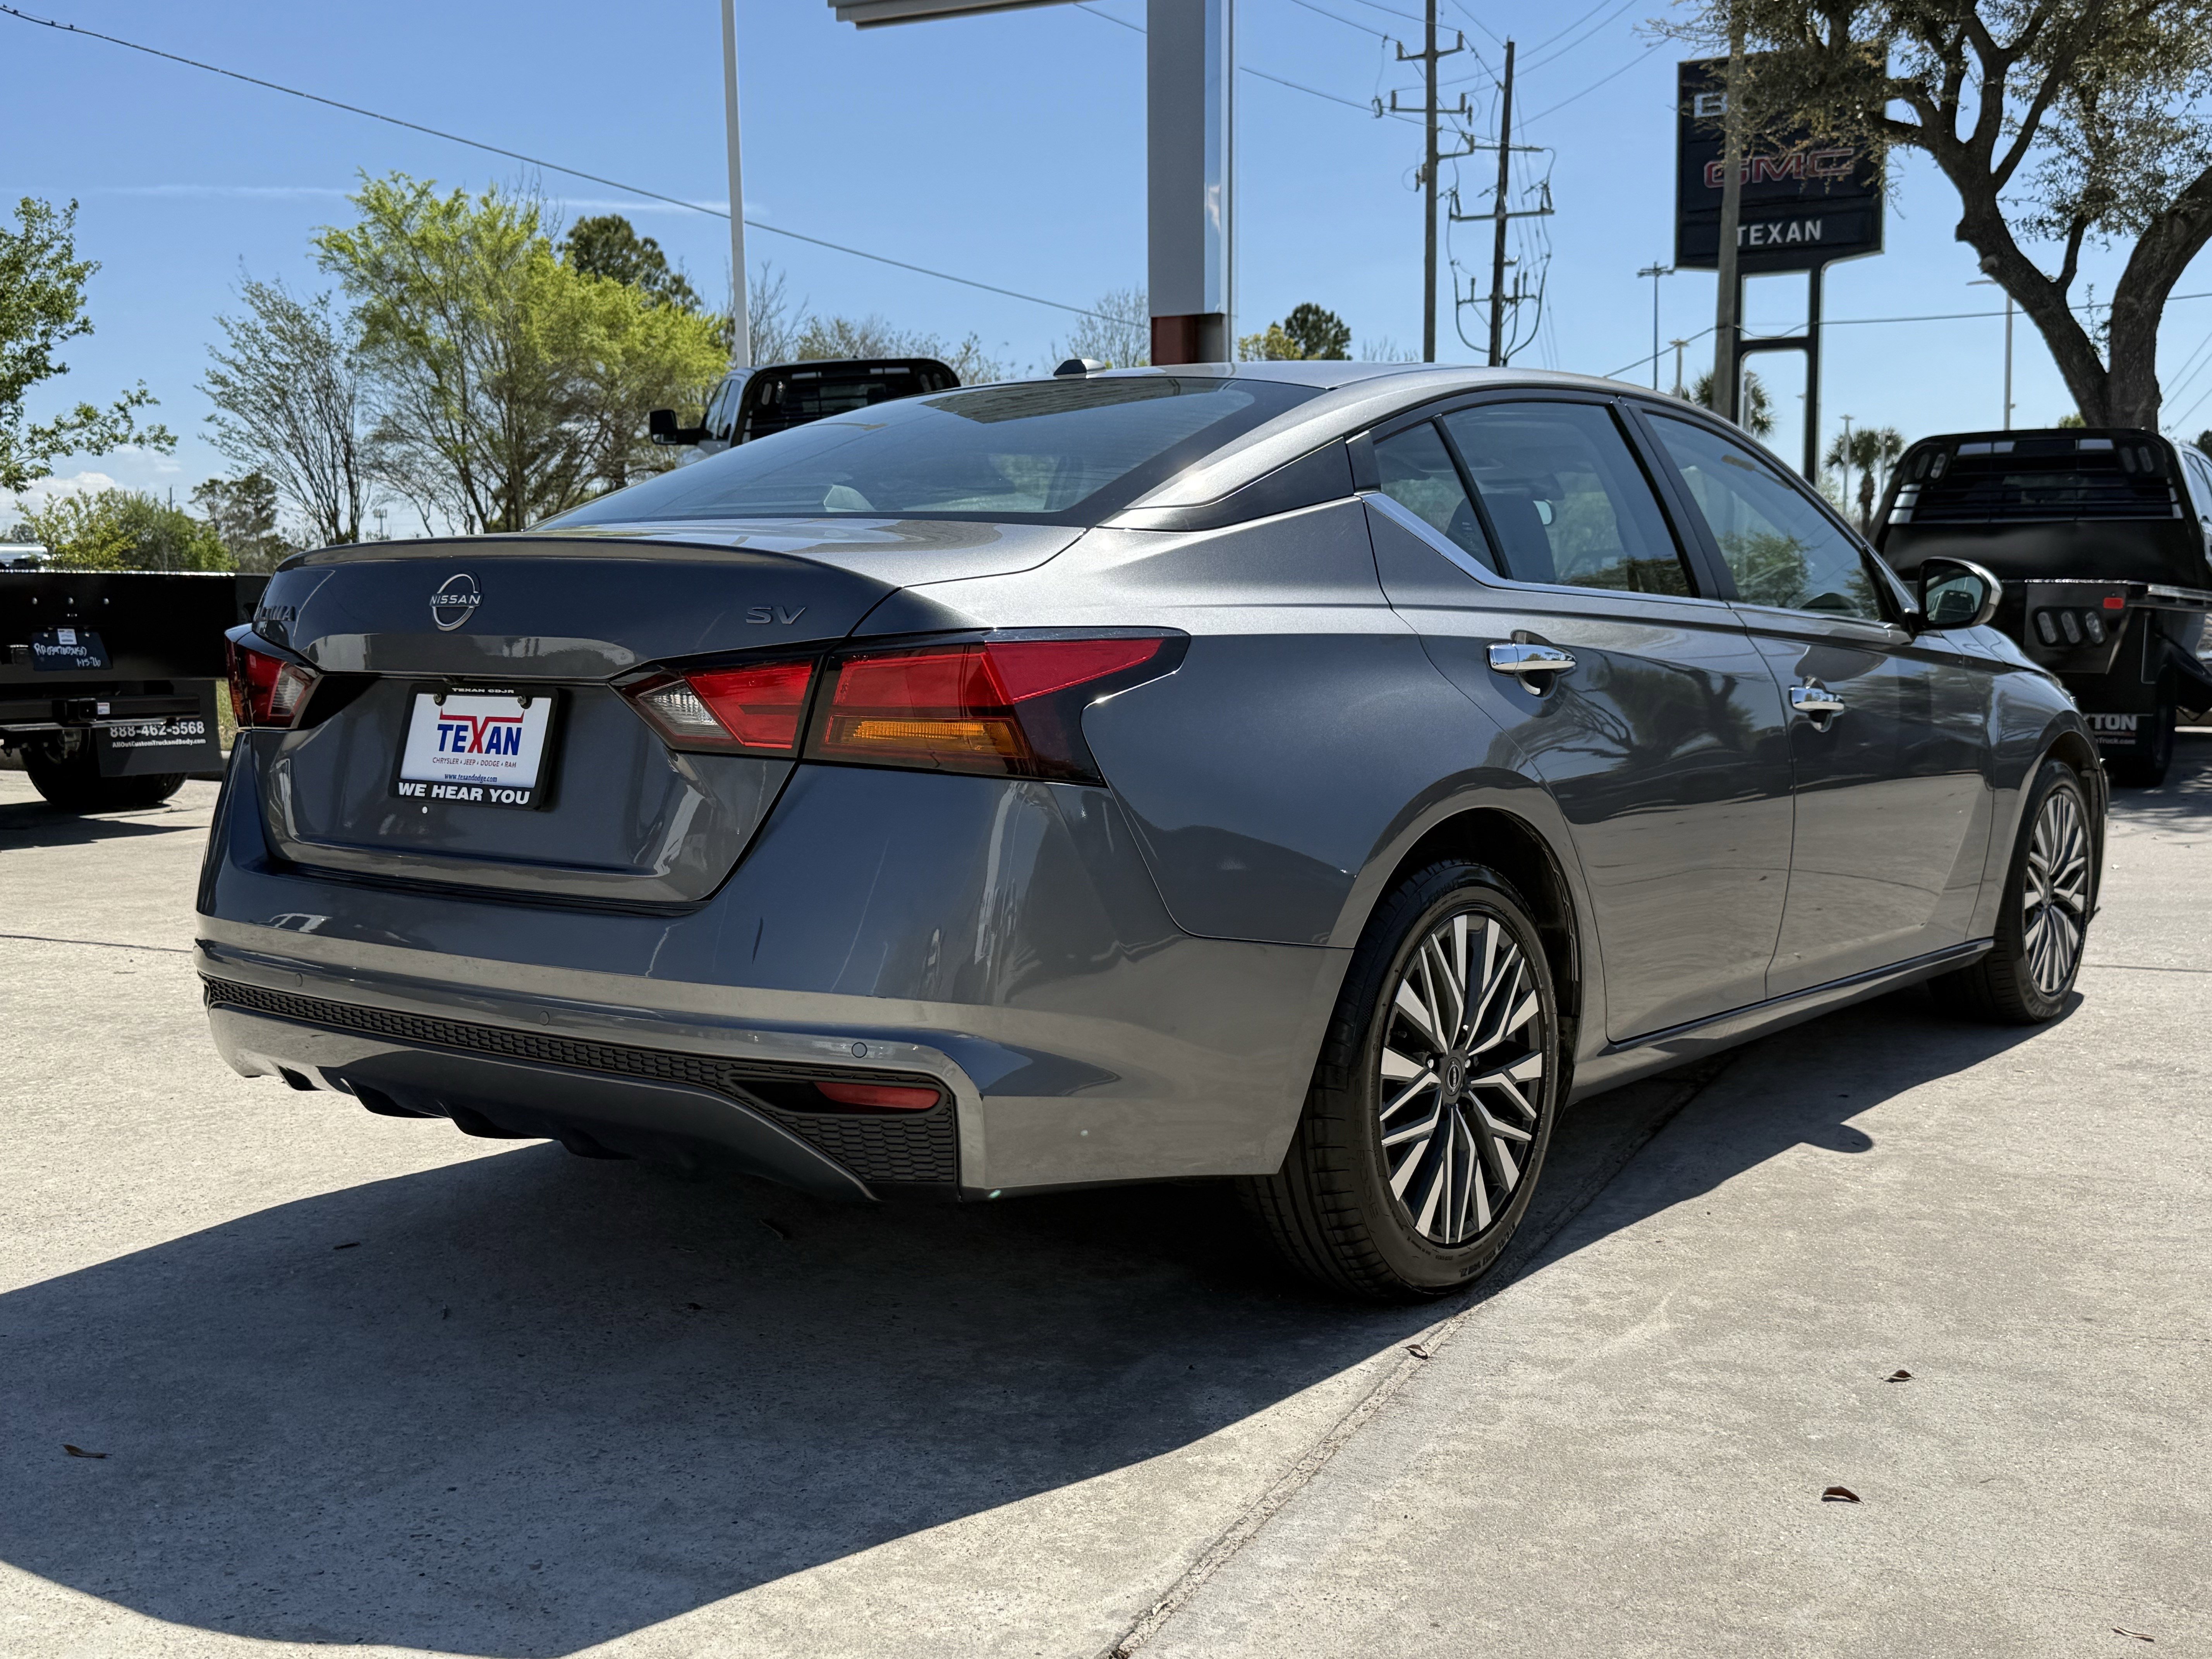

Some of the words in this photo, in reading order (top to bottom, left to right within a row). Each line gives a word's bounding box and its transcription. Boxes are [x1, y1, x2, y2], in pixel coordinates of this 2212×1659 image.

[1704, 147, 1855, 188] GMC
[1736, 219, 1822, 246] TEXAN
[429, 594, 481, 604] NISSAN
[746, 606, 807, 624] SV
[437, 713, 523, 755] TEXAN
[445, 774, 497, 783] www.texandodge.com
[398, 782, 427, 797] WE
[431, 785, 483, 801] HEAR
[489, 788, 531, 804] YOU
